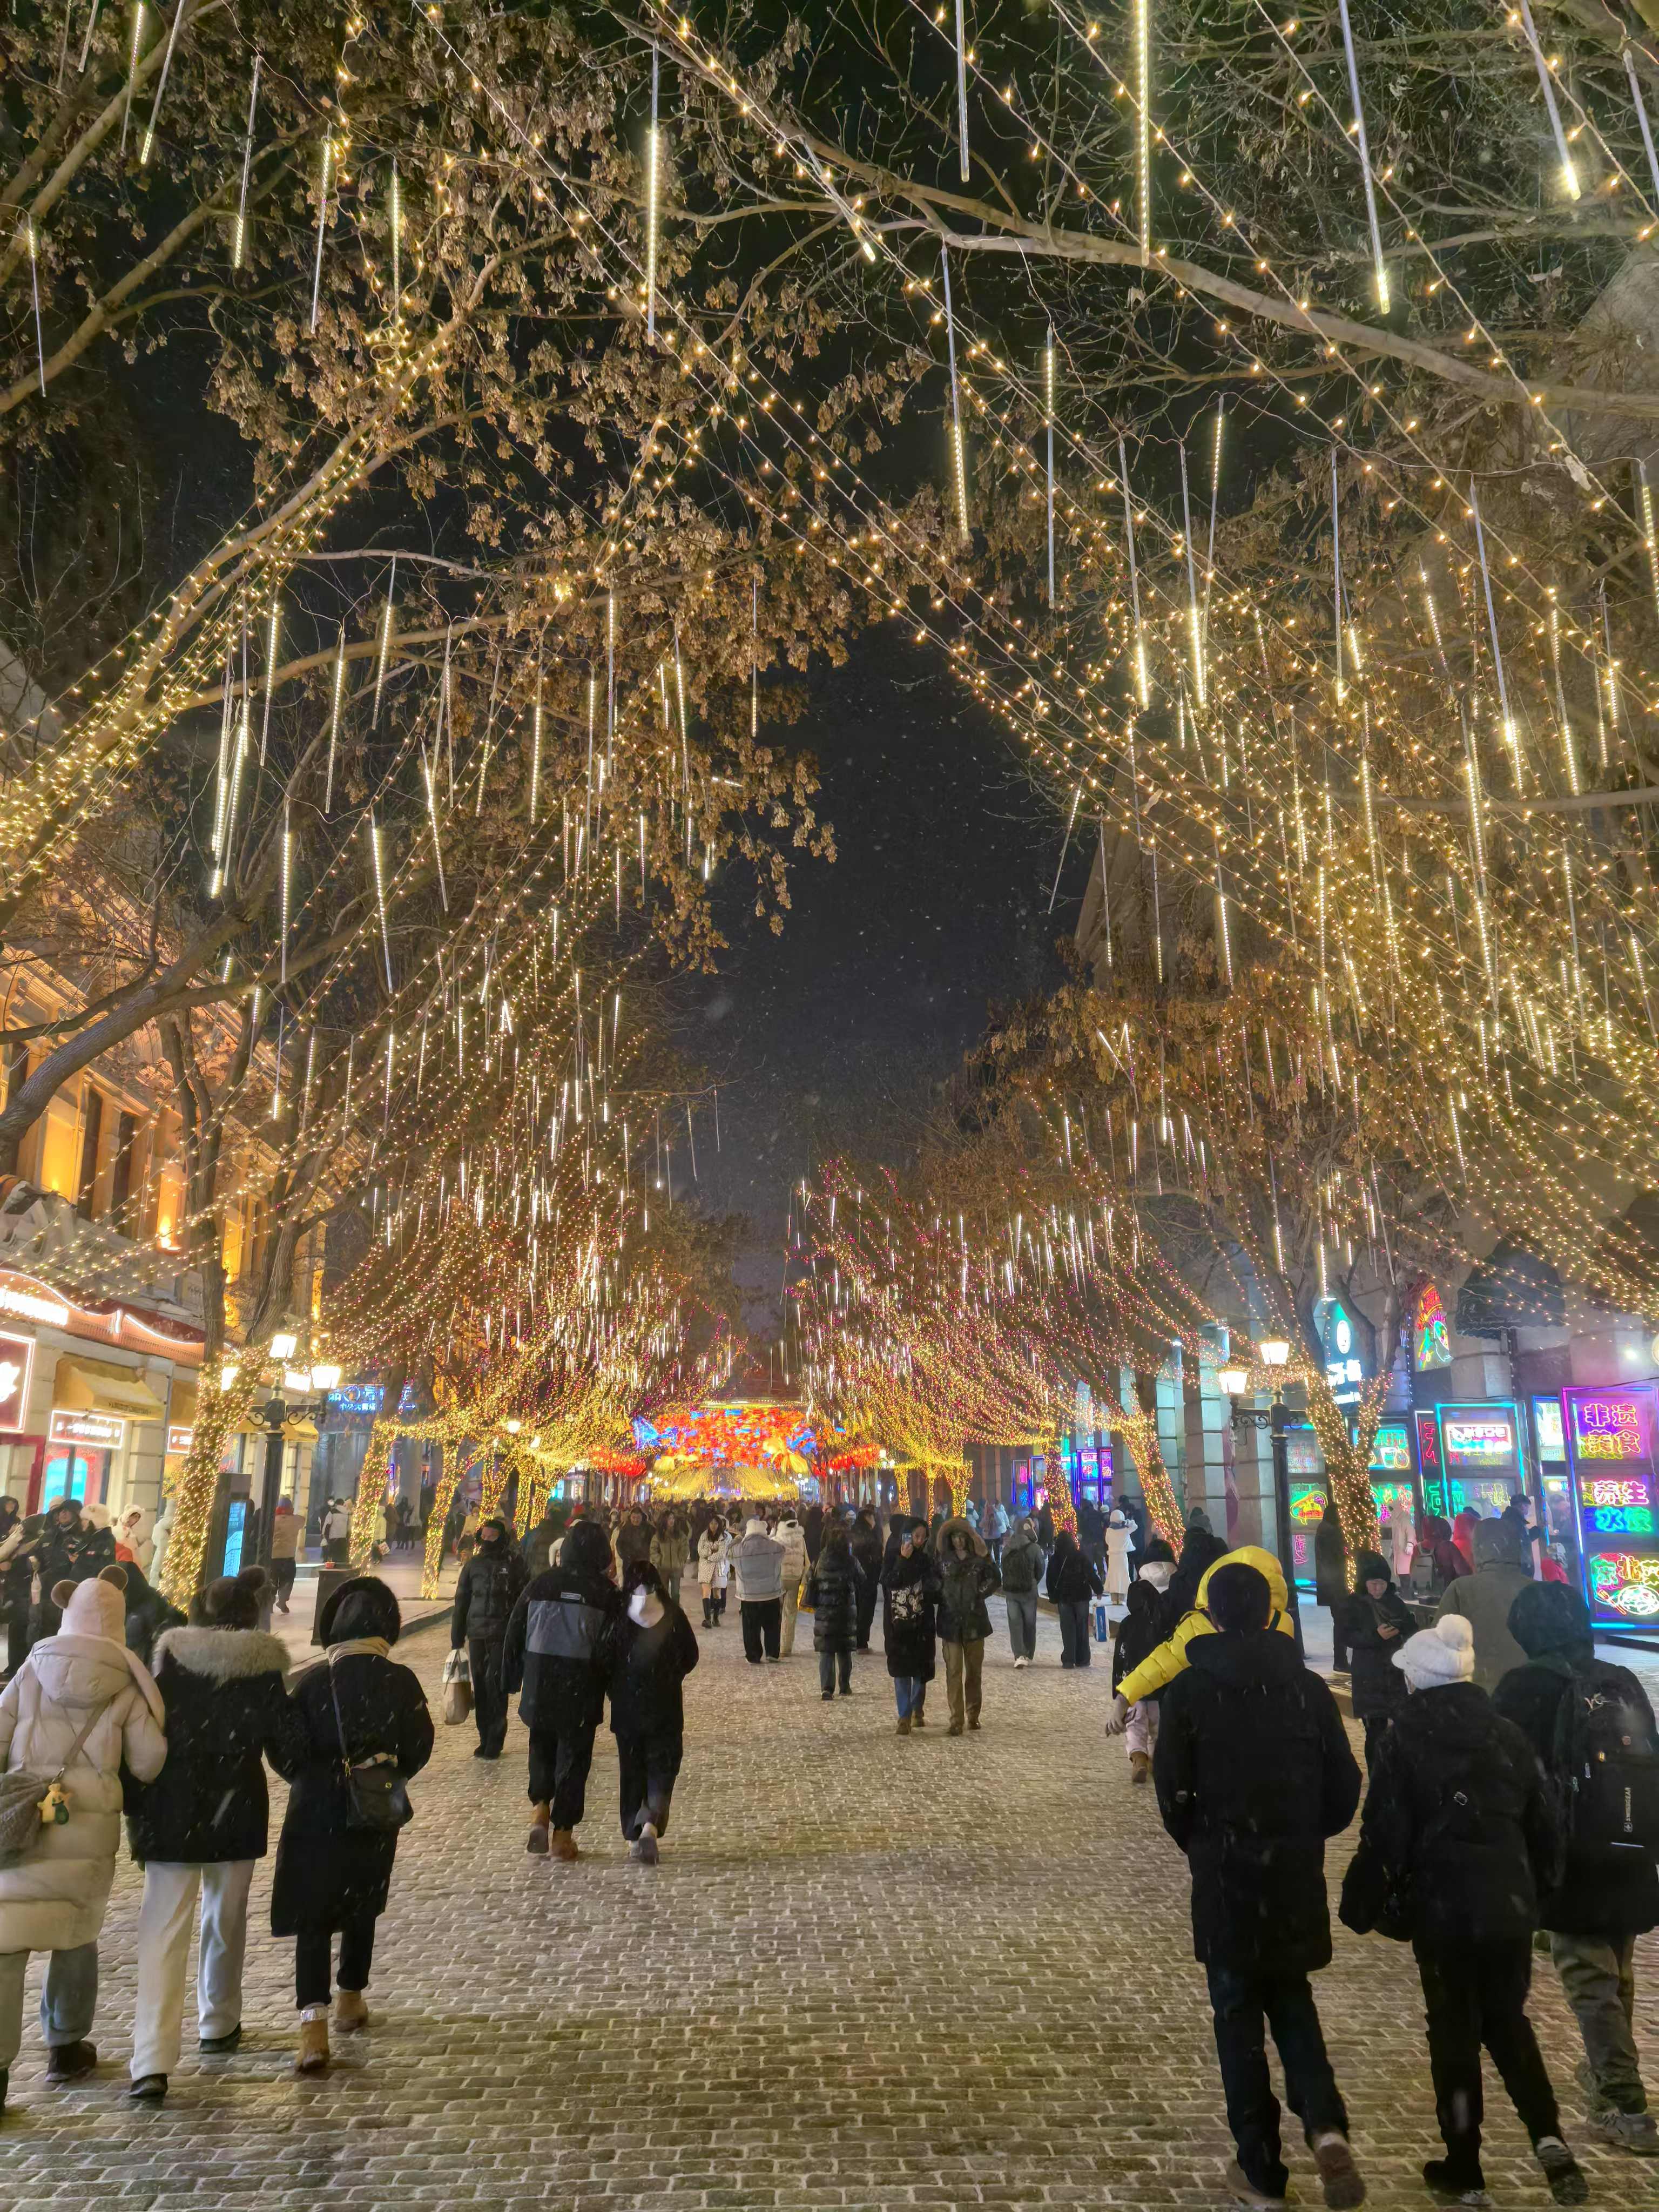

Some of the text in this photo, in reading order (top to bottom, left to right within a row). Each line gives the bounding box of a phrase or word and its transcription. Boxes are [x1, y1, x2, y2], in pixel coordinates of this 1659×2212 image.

[1583, 1403, 1638, 1427] 非遗
[1587, 1429, 1641, 1453] 美食
[1594, 1480, 1649, 1505] 养生
